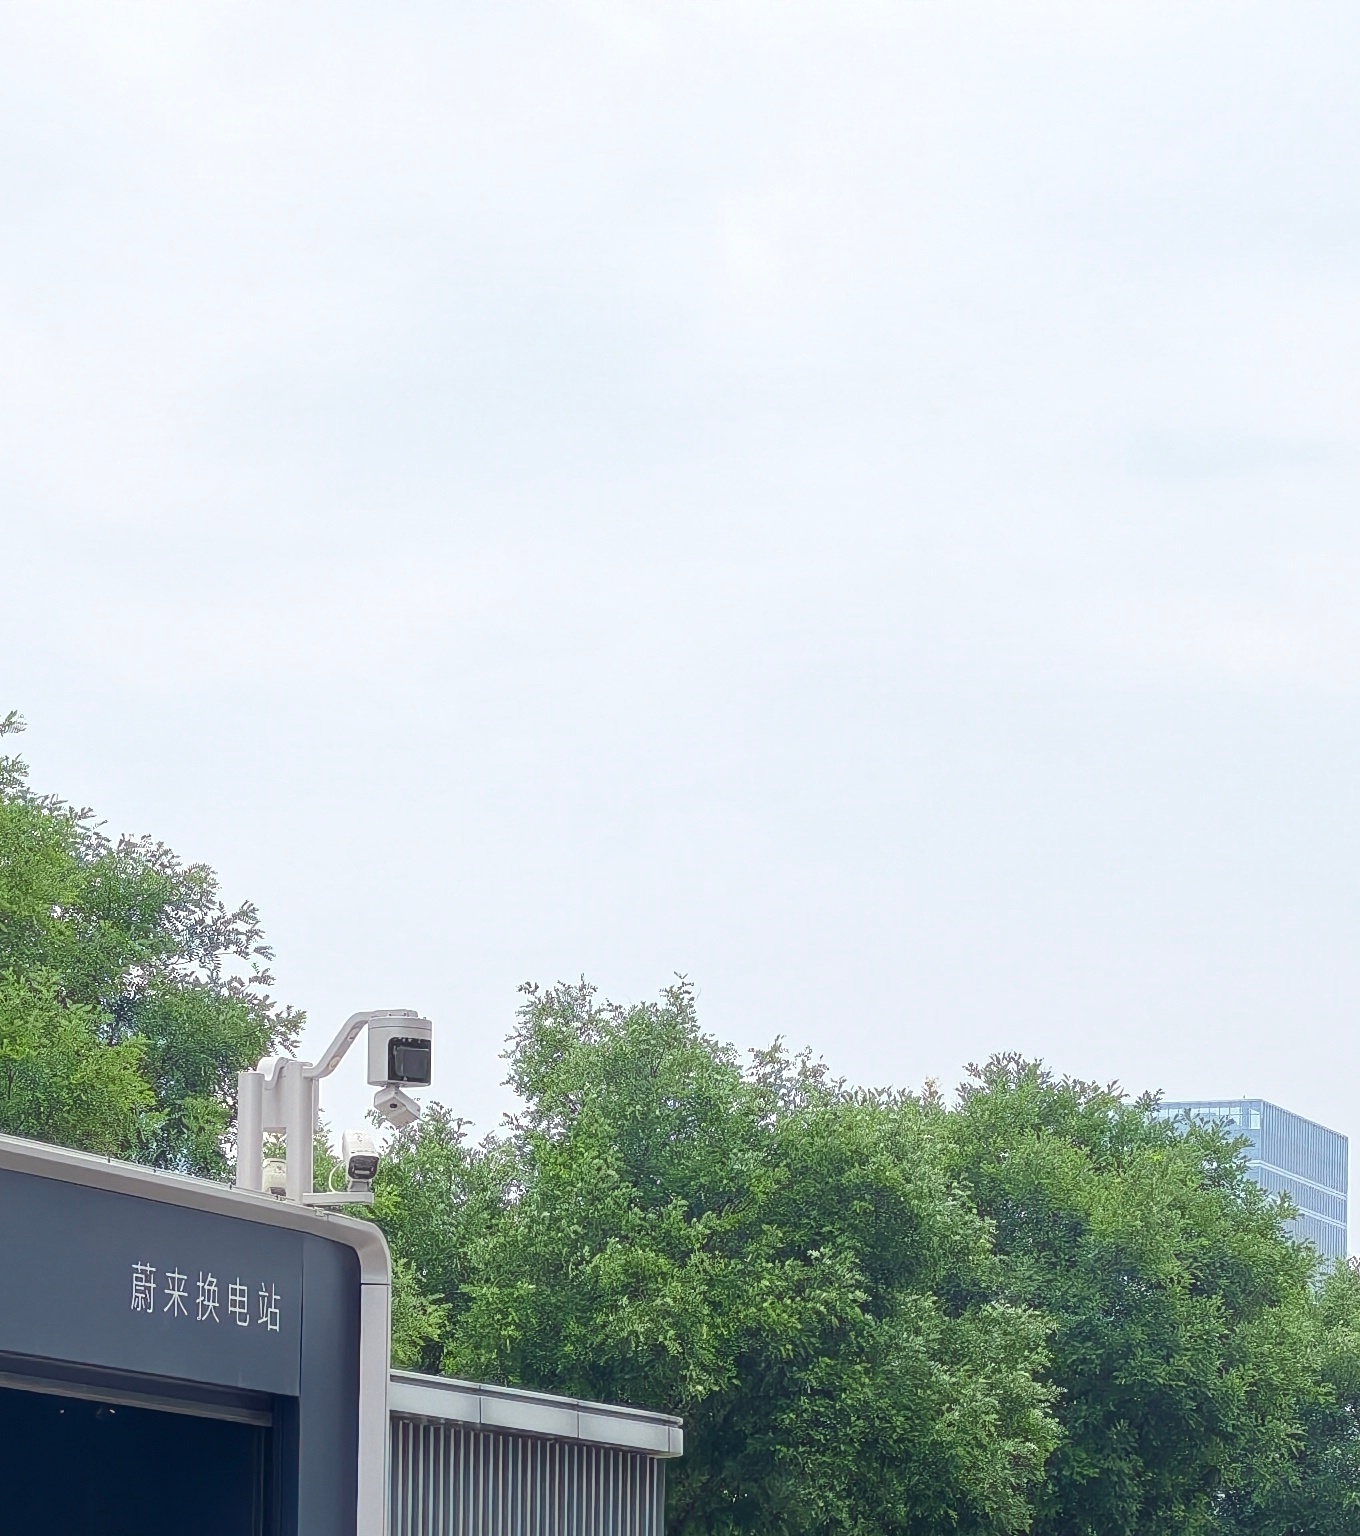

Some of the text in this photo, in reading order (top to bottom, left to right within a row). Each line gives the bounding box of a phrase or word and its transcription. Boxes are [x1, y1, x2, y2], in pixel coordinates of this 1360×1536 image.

[130, 1260, 281, 1332] 蔚来换电站
